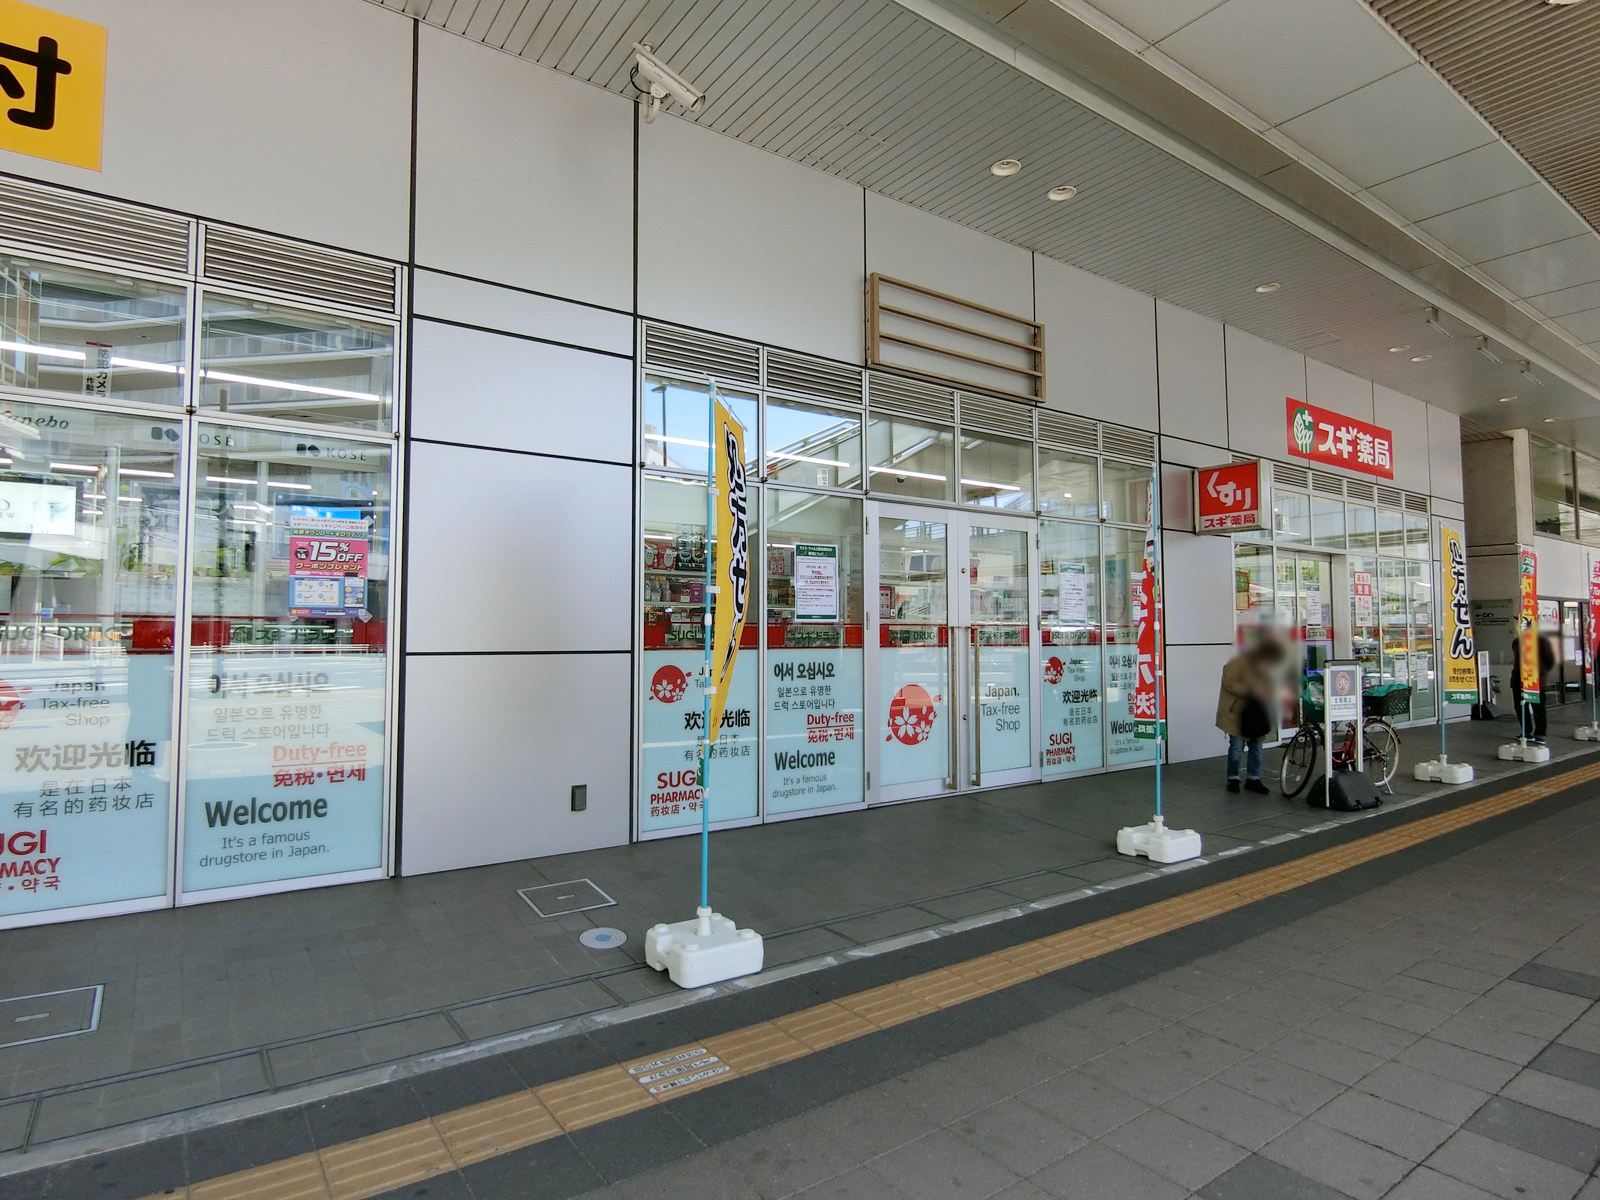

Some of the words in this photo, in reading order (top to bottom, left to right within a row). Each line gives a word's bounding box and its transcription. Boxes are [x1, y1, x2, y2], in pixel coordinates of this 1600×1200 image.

[1318, 422, 1390, 469] スギ薬局
[1207, 471, 1252, 510] くすり
[1204, 514, 1256, 528] スギ薬局
[310, 541, 350, 561] 15%
[336, 553, 363, 562] OFF
[296, 562, 363, 571] クーポンプレゼント
[914, 631, 935, 640] DRUG
[774, 662, 793, 681] 어서
[796, 661, 835, 680] 오십시오
[777, 687, 807, 698] 일본으로
[810, 686, 831, 696] 유명한
[985, 686, 1020, 700] Japan.
[40, 697, 110, 710] Tax-free
[773, 701, 789, 711] 드럭
[791, 698, 836, 711] 스토어입니다
[980, 702, 1020, 717] Tax-free
[65, 714, 109, 727] Shop
[214, 707, 274, 723] 일본으로
[280, 704, 323, 720] 유명한
[807, 712, 854, 727] Duty-free
[206, 727, 236, 742] 드럭
[241, 723, 330, 740] 스토어입니다
[996, 718, 1020, 733] Shop
[1049, 732, 1073, 746] SUGI
[15, 740, 157, 773] 欢迎光临
[272, 742, 367, 763] Duty-free
[1046, 746, 1075, 757] PHARMACY
[774, 750, 836, 771] Welcome
[40, 776, 132, 797] 是在日本
[783, 776, 795, 786] It's
[802, 773, 827, 785] famous
[772, 787, 805, 799] drugstore
[807, 785, 814, 794] in
[816, 783, 837, 794] Japan.
[13, 793, 155, 818] 有名的药妆店
[205, 797, 328, 828] Welcome
[222, 836, 244, 849] It's
[248, 836, 257, 846] a
[262, 831, 310, 845] famous
[200, 850, 267, 867] drugstore
[272, 848, 283, 859] in
[288, 843, 330, 858] Japan.
